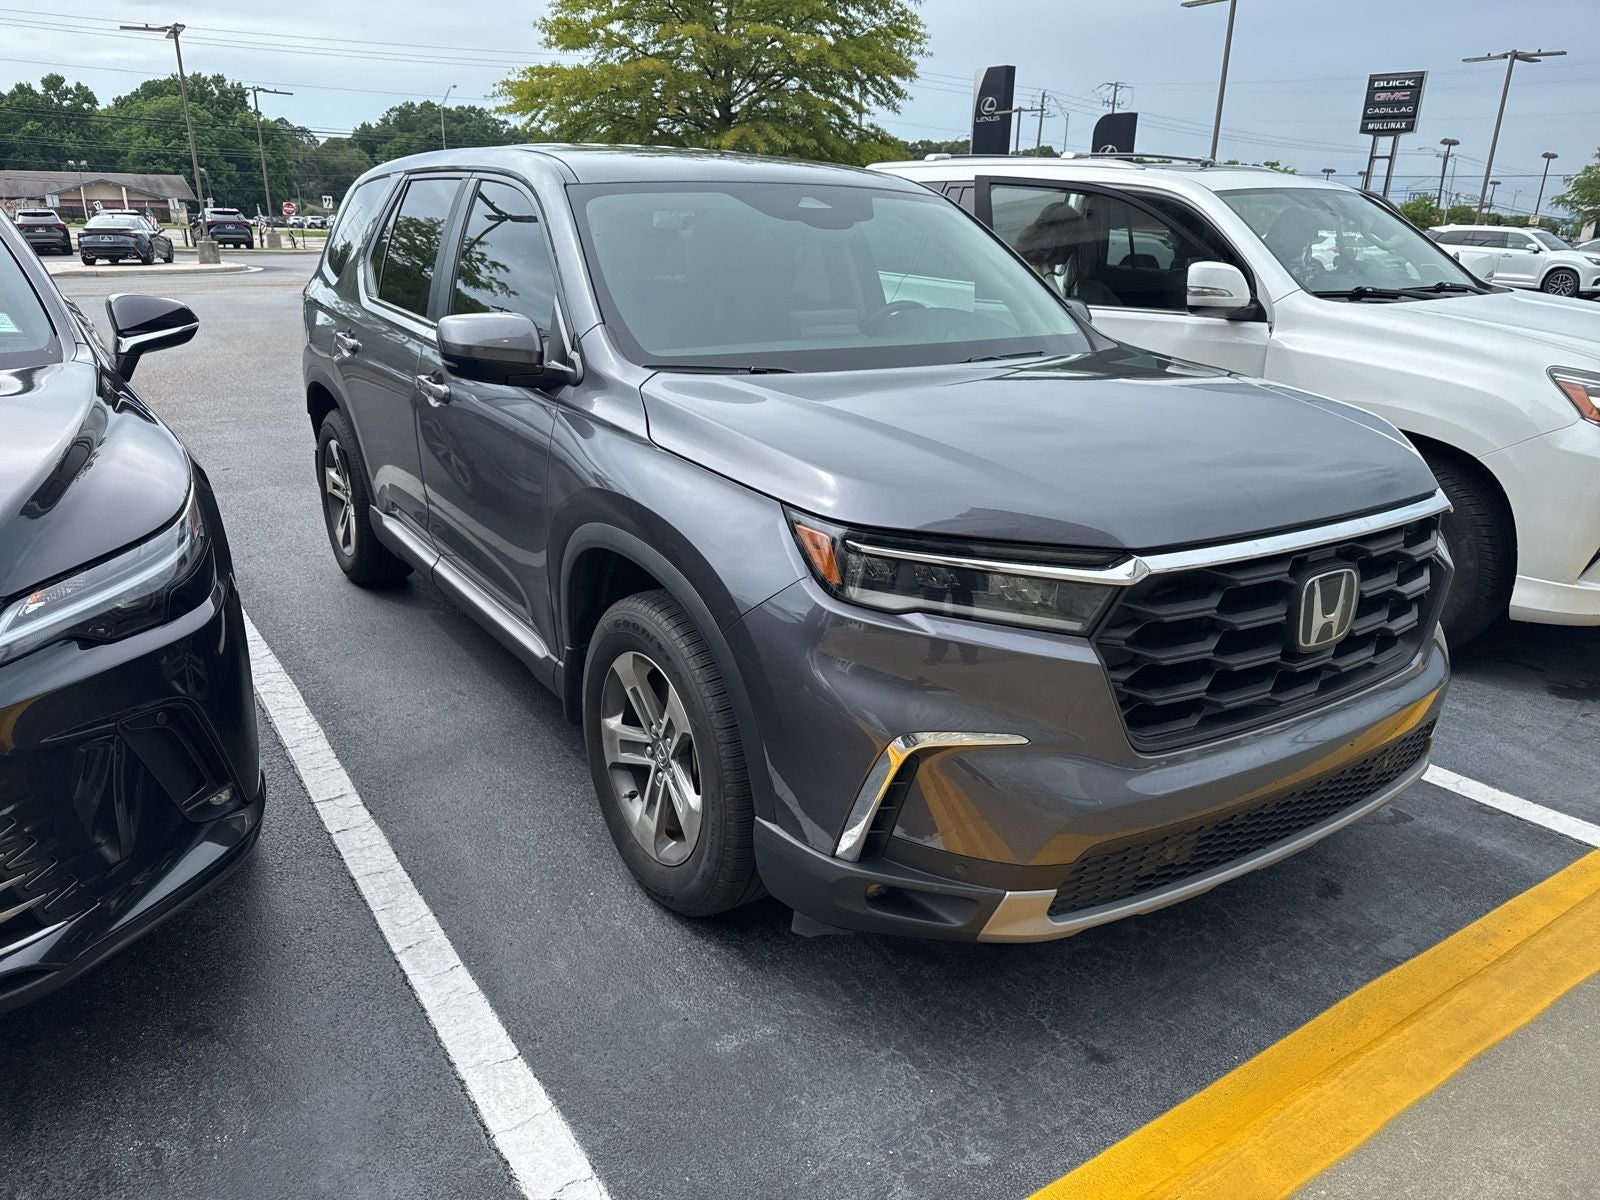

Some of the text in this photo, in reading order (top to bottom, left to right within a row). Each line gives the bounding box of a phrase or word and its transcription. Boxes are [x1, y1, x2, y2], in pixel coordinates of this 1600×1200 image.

[1374, 79, 1415, 88] BUICK
[1375, 91, 1411, 101] GMC
[1367, 106, 1413, 115] CADILLAC
[976, 115, 1000, 123] LEXUS
[1367, 121, 1407, 130] MULLINAX
